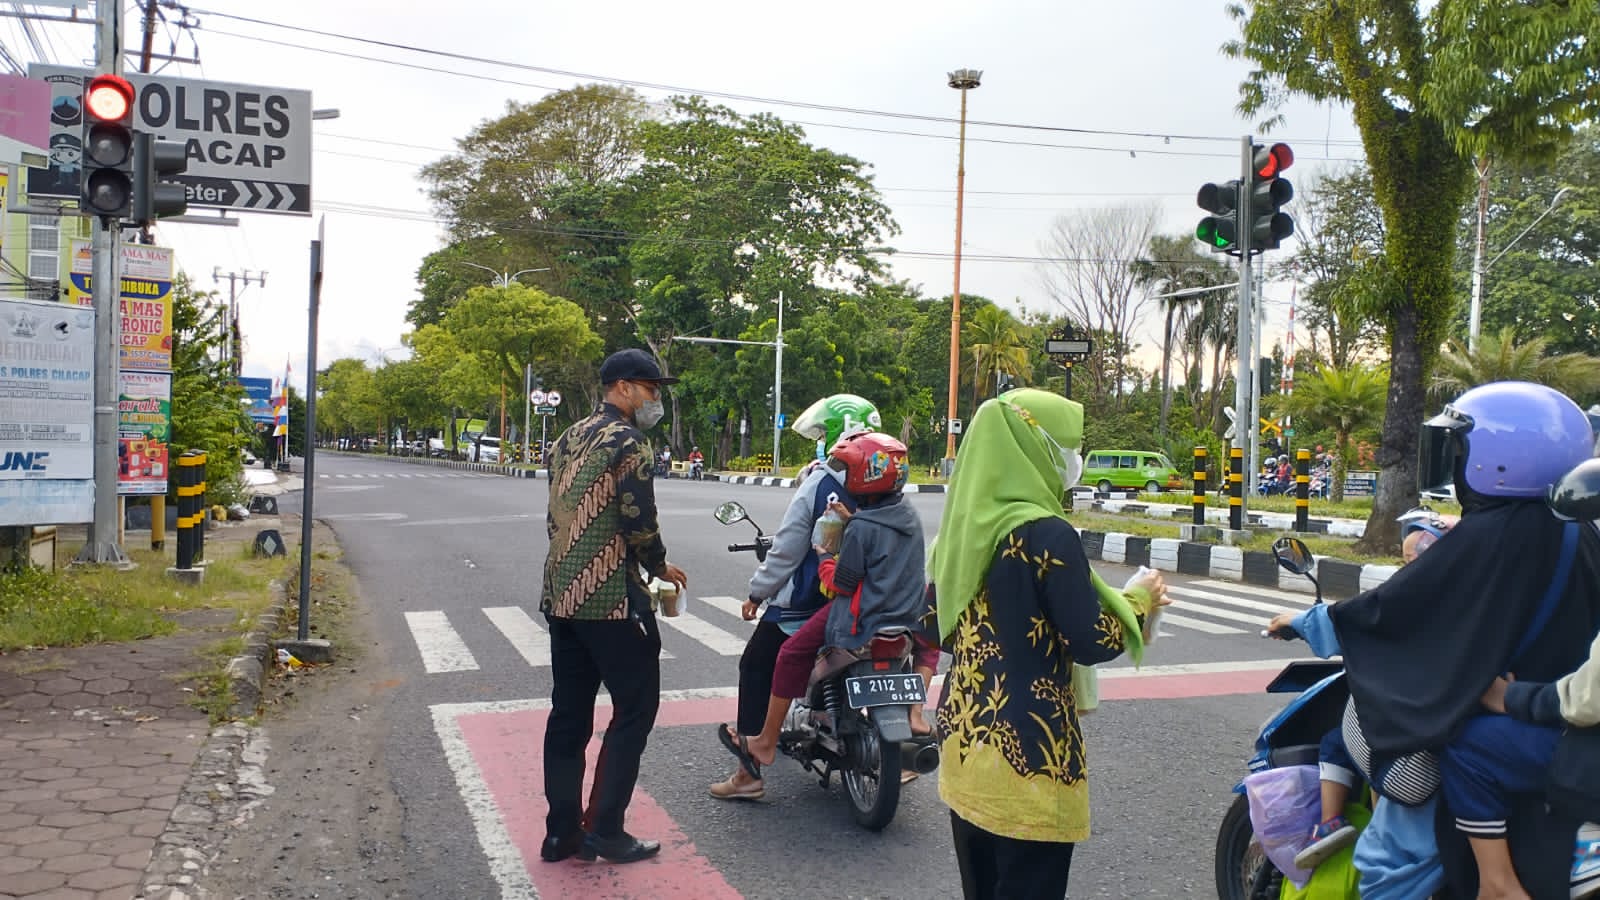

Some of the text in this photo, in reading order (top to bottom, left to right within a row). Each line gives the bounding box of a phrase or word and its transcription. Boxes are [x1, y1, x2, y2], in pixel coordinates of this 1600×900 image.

[139, 83, 290, 139] OLRES
[158, 136, 286, 169] ACAP
[172, 181, 228, 202] eter
[120, 248, 143, 258] AMA
[132, 301, 164, 318] MAS
[120, 318, 162, 334] RONIC
[11, 367, 49, 379] POLRES
[51, 368, 91, 382] CILACAP
[118, 397, 160, 412] arak
[852, 682, 862, 695] R
[869, 679, 896, 692] 2112
